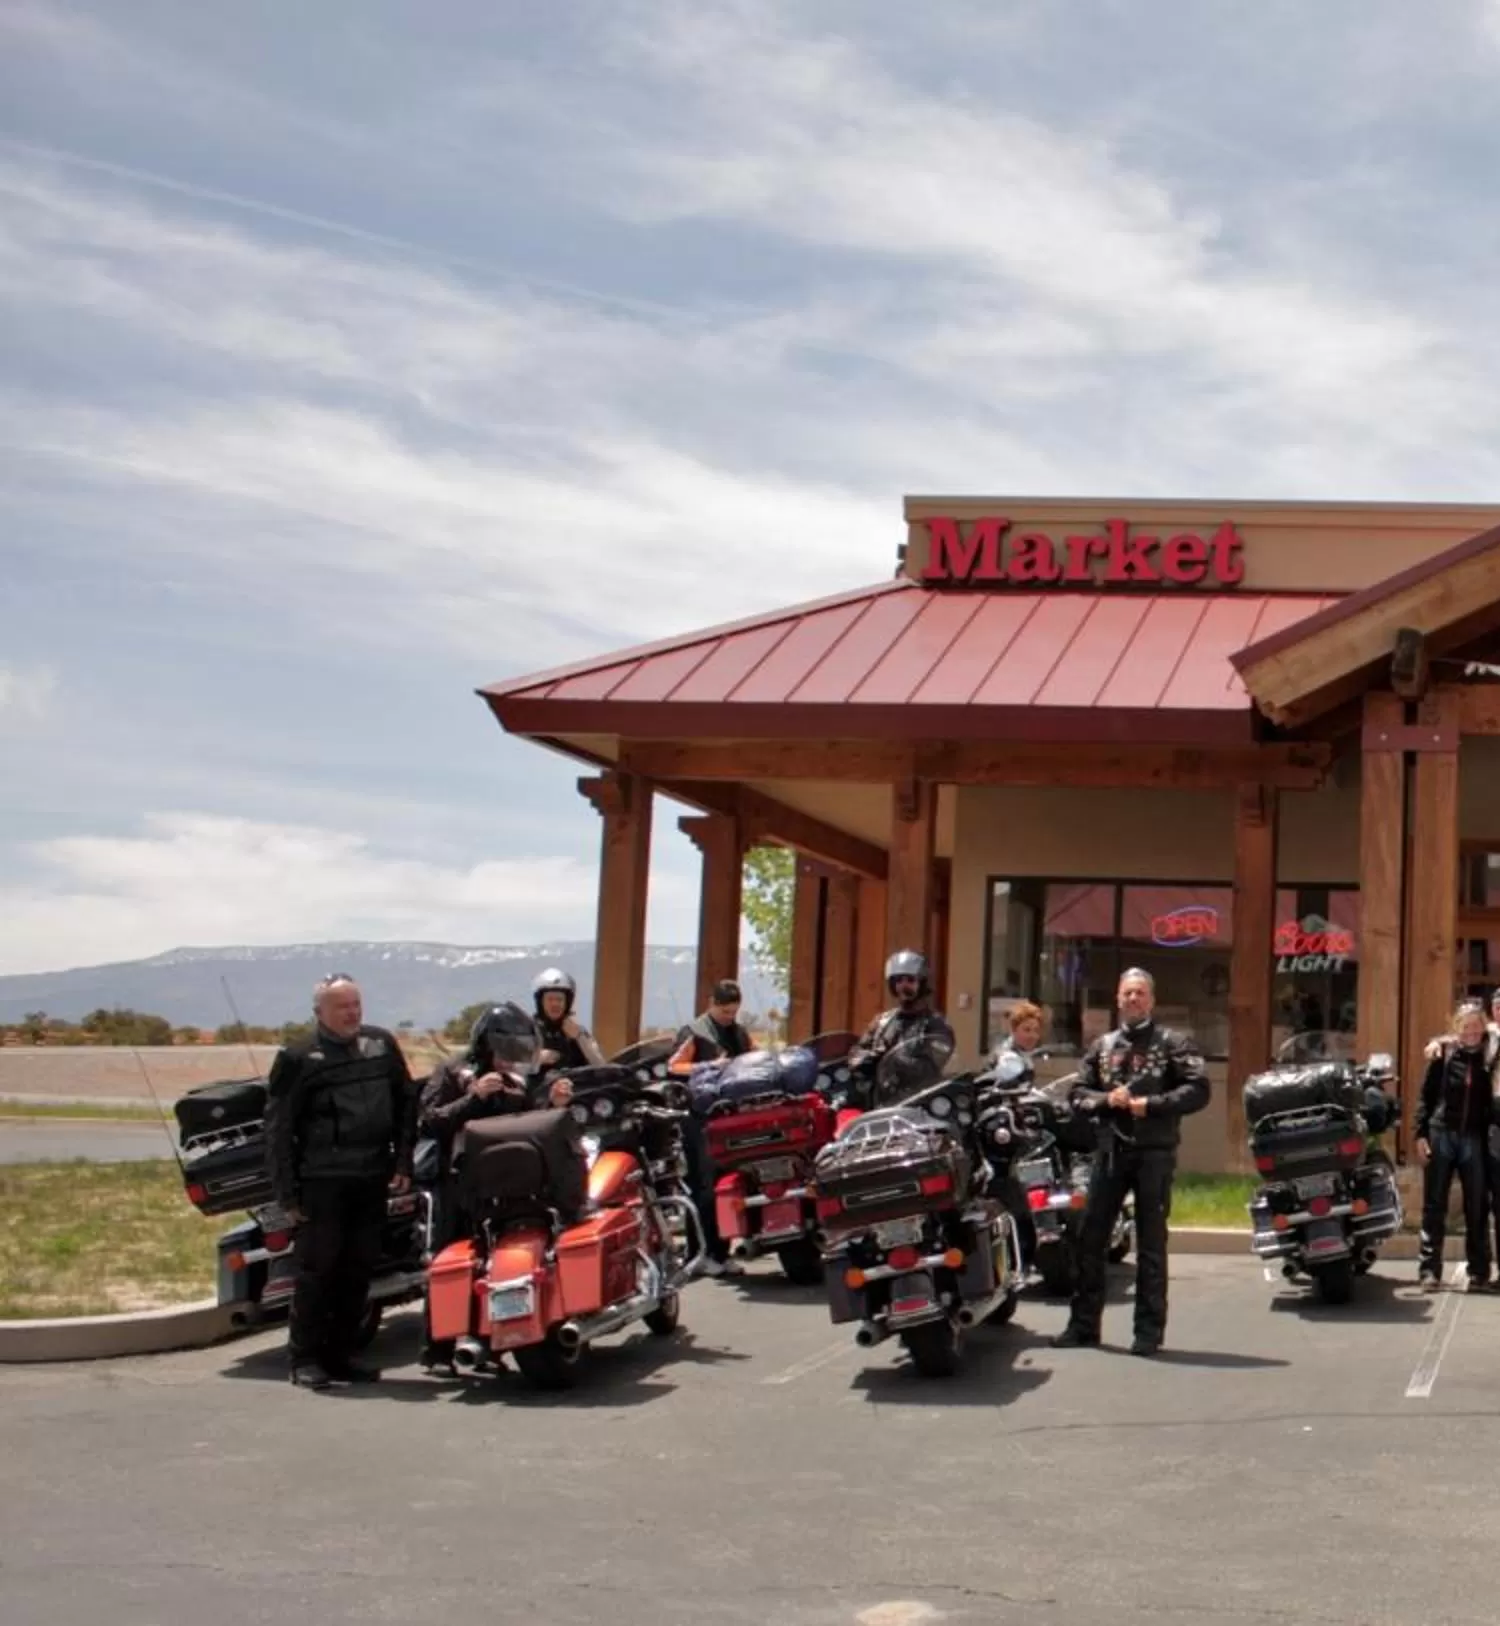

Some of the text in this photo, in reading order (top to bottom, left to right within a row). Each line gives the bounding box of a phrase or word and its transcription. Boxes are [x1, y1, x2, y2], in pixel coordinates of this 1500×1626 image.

[922, 517, 1245, 584] Market
[1152, 914, 1217, 939] OPEN
[1276, 955, 1346, 973] LIGHT
